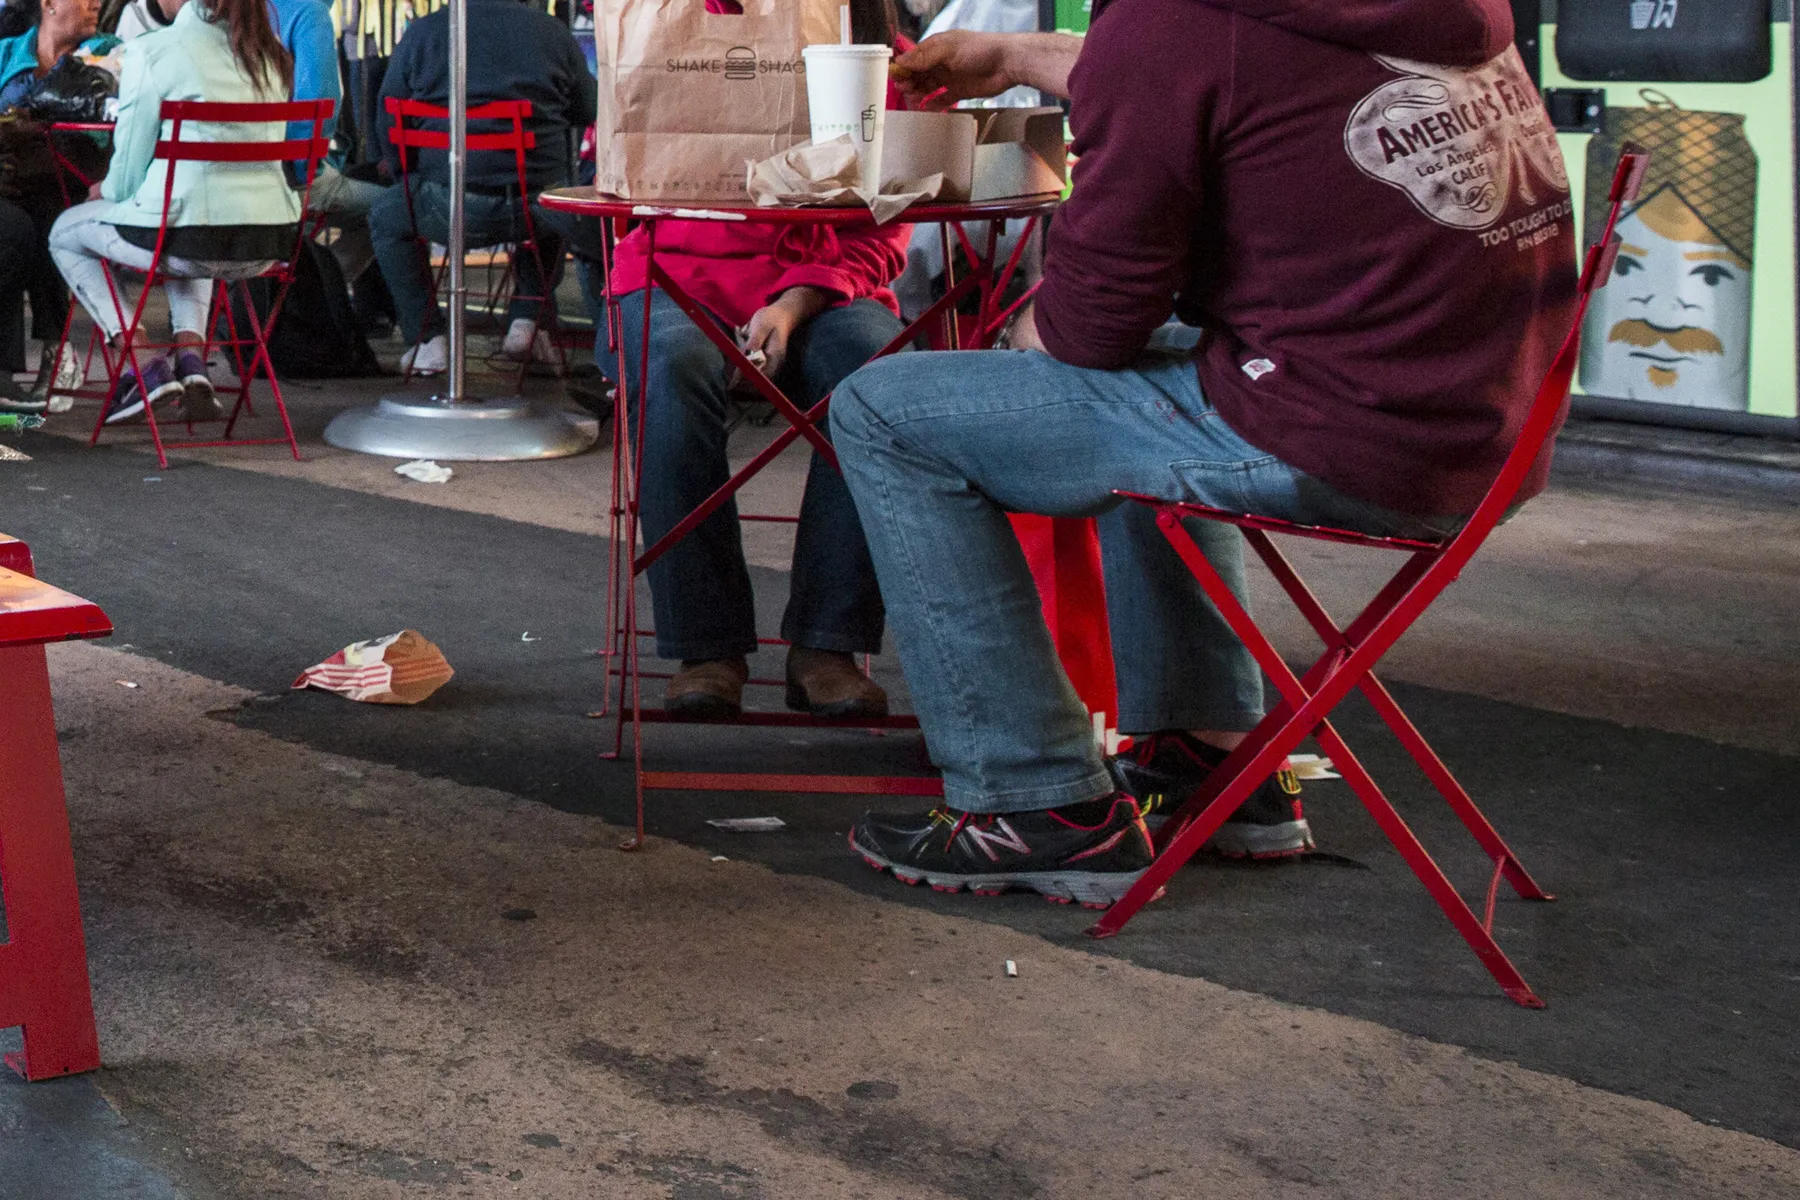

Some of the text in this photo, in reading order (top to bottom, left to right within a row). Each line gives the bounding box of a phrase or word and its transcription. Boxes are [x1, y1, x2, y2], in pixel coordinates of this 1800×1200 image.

[666, 58, 722, 74] SHAKE
[1375, 92, 1502, 166] AMERICA'S
[1415, 162, 1444, 179] Los
[1478, 228, 1509, 248] TOO
[1509, 211, 1549, 237] TOUGH
[1547, 202, 1564, 222] TO
